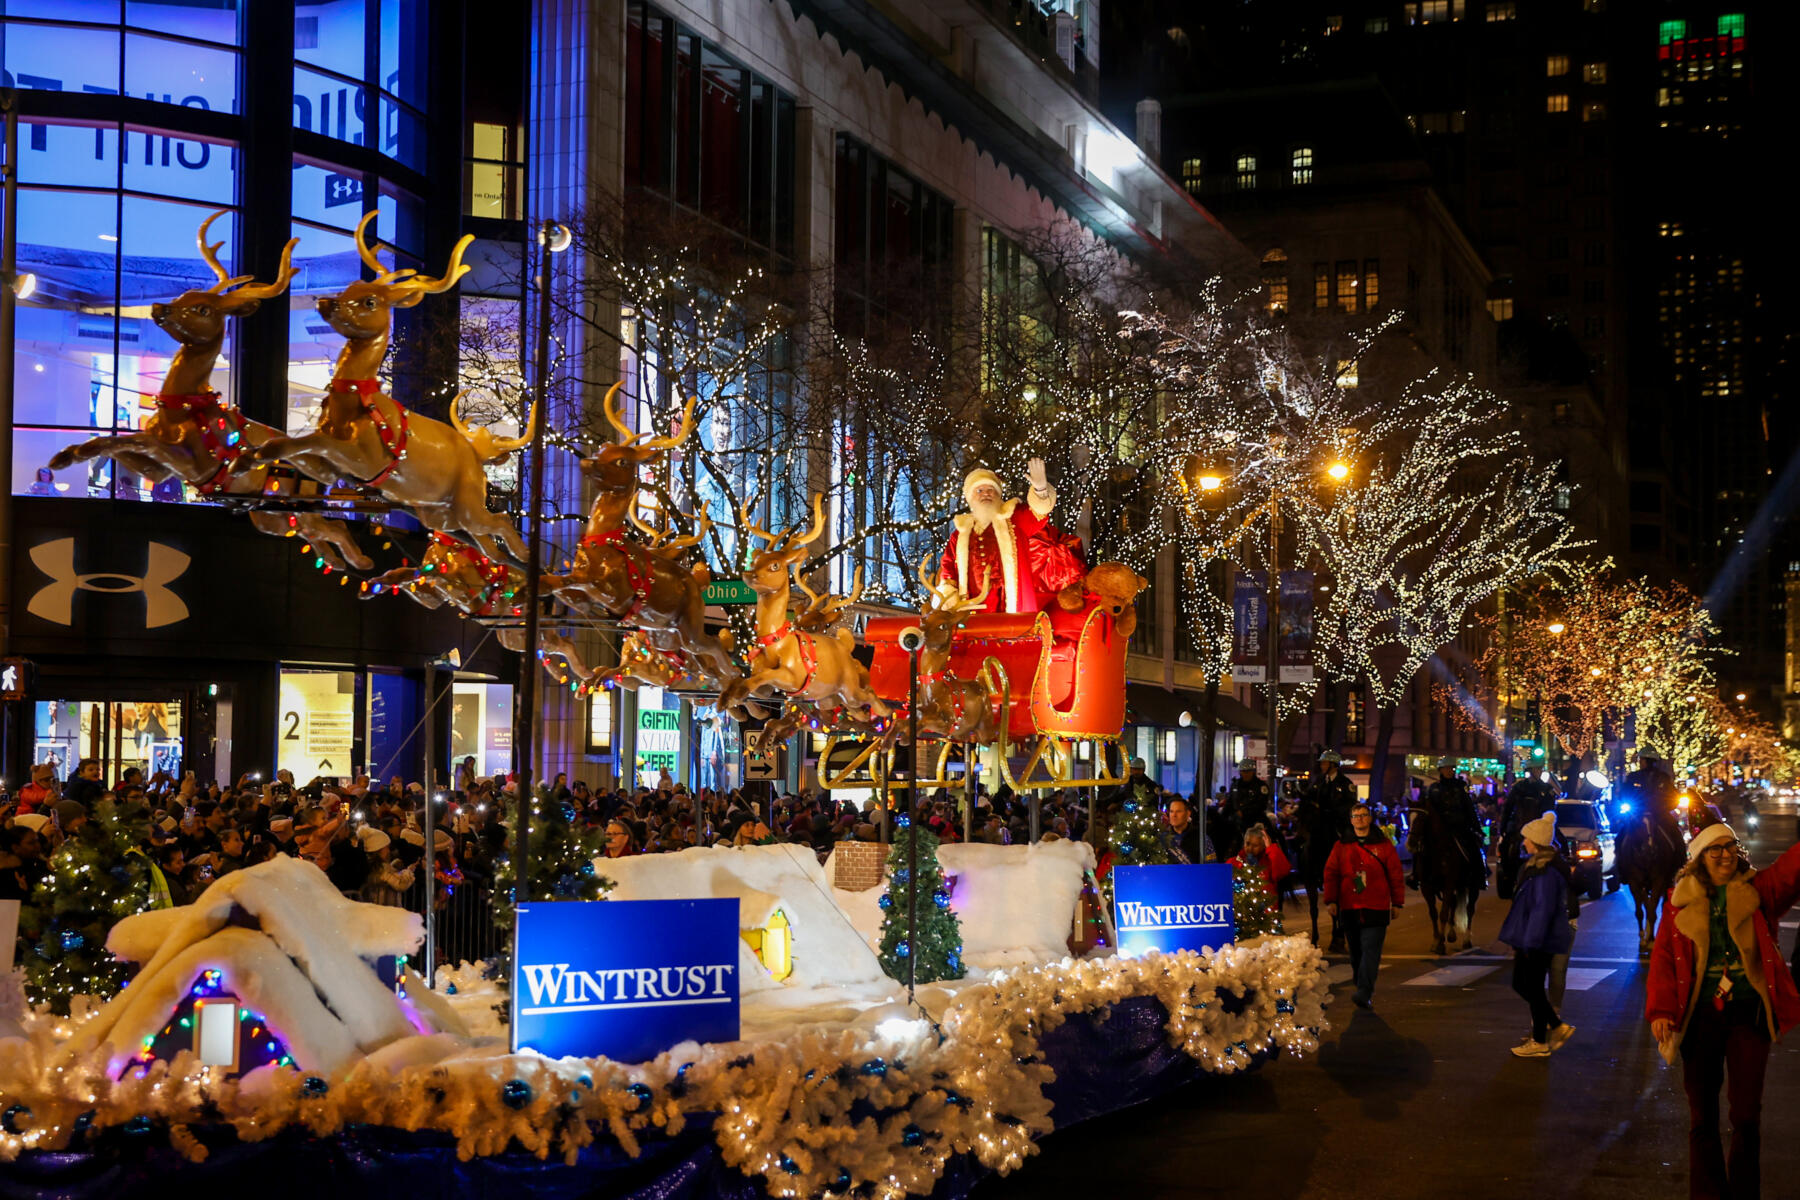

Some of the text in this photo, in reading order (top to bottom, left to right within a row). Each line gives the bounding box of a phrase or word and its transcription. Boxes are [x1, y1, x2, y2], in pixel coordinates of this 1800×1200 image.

[707, 585, 738, 599] Ohio
[284, 711, 300, 740] 2
[1117, 901, 1231, 926] WINTRUST
[521, 963, 734, 1006] WINTRUST
